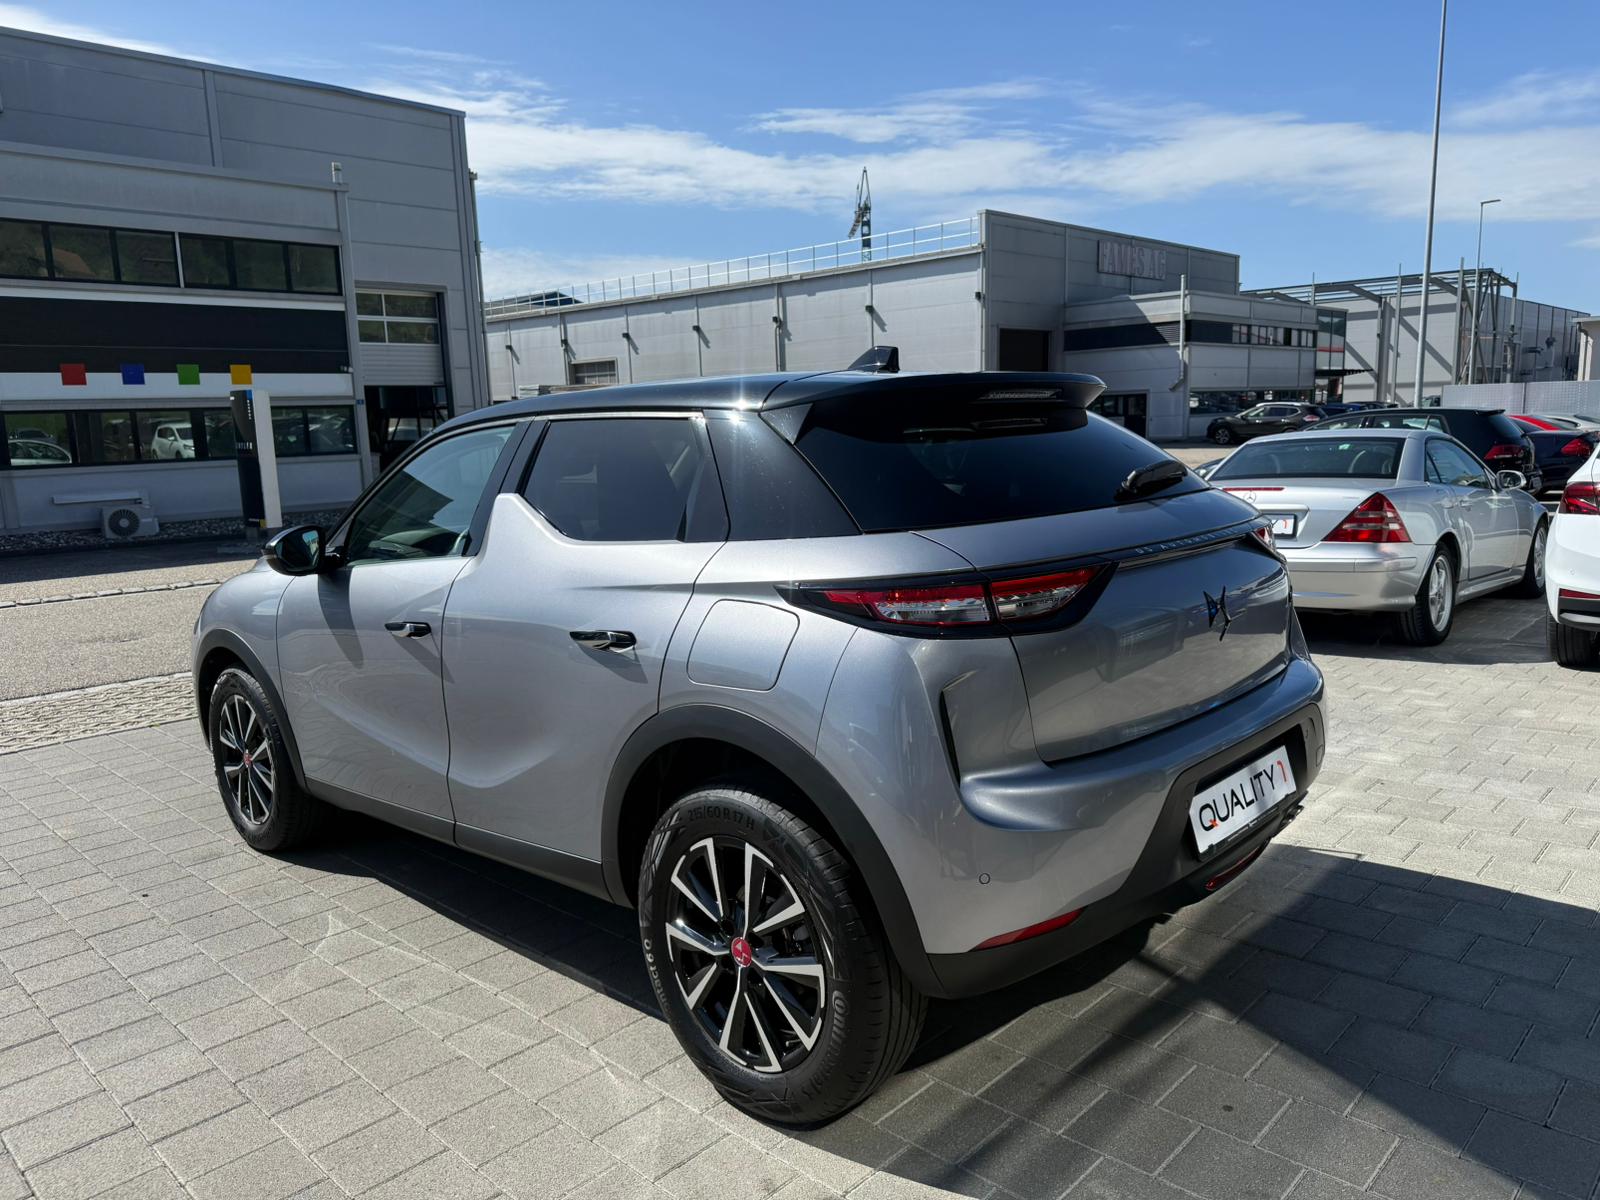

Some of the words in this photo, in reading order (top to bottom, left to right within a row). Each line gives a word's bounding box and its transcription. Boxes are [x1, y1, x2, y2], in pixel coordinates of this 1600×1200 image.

[687, 805, 721, 821] 215/60
[1199, 764, 1275, 831] QUALITY
[1276, 760, 1287, 783] 1
